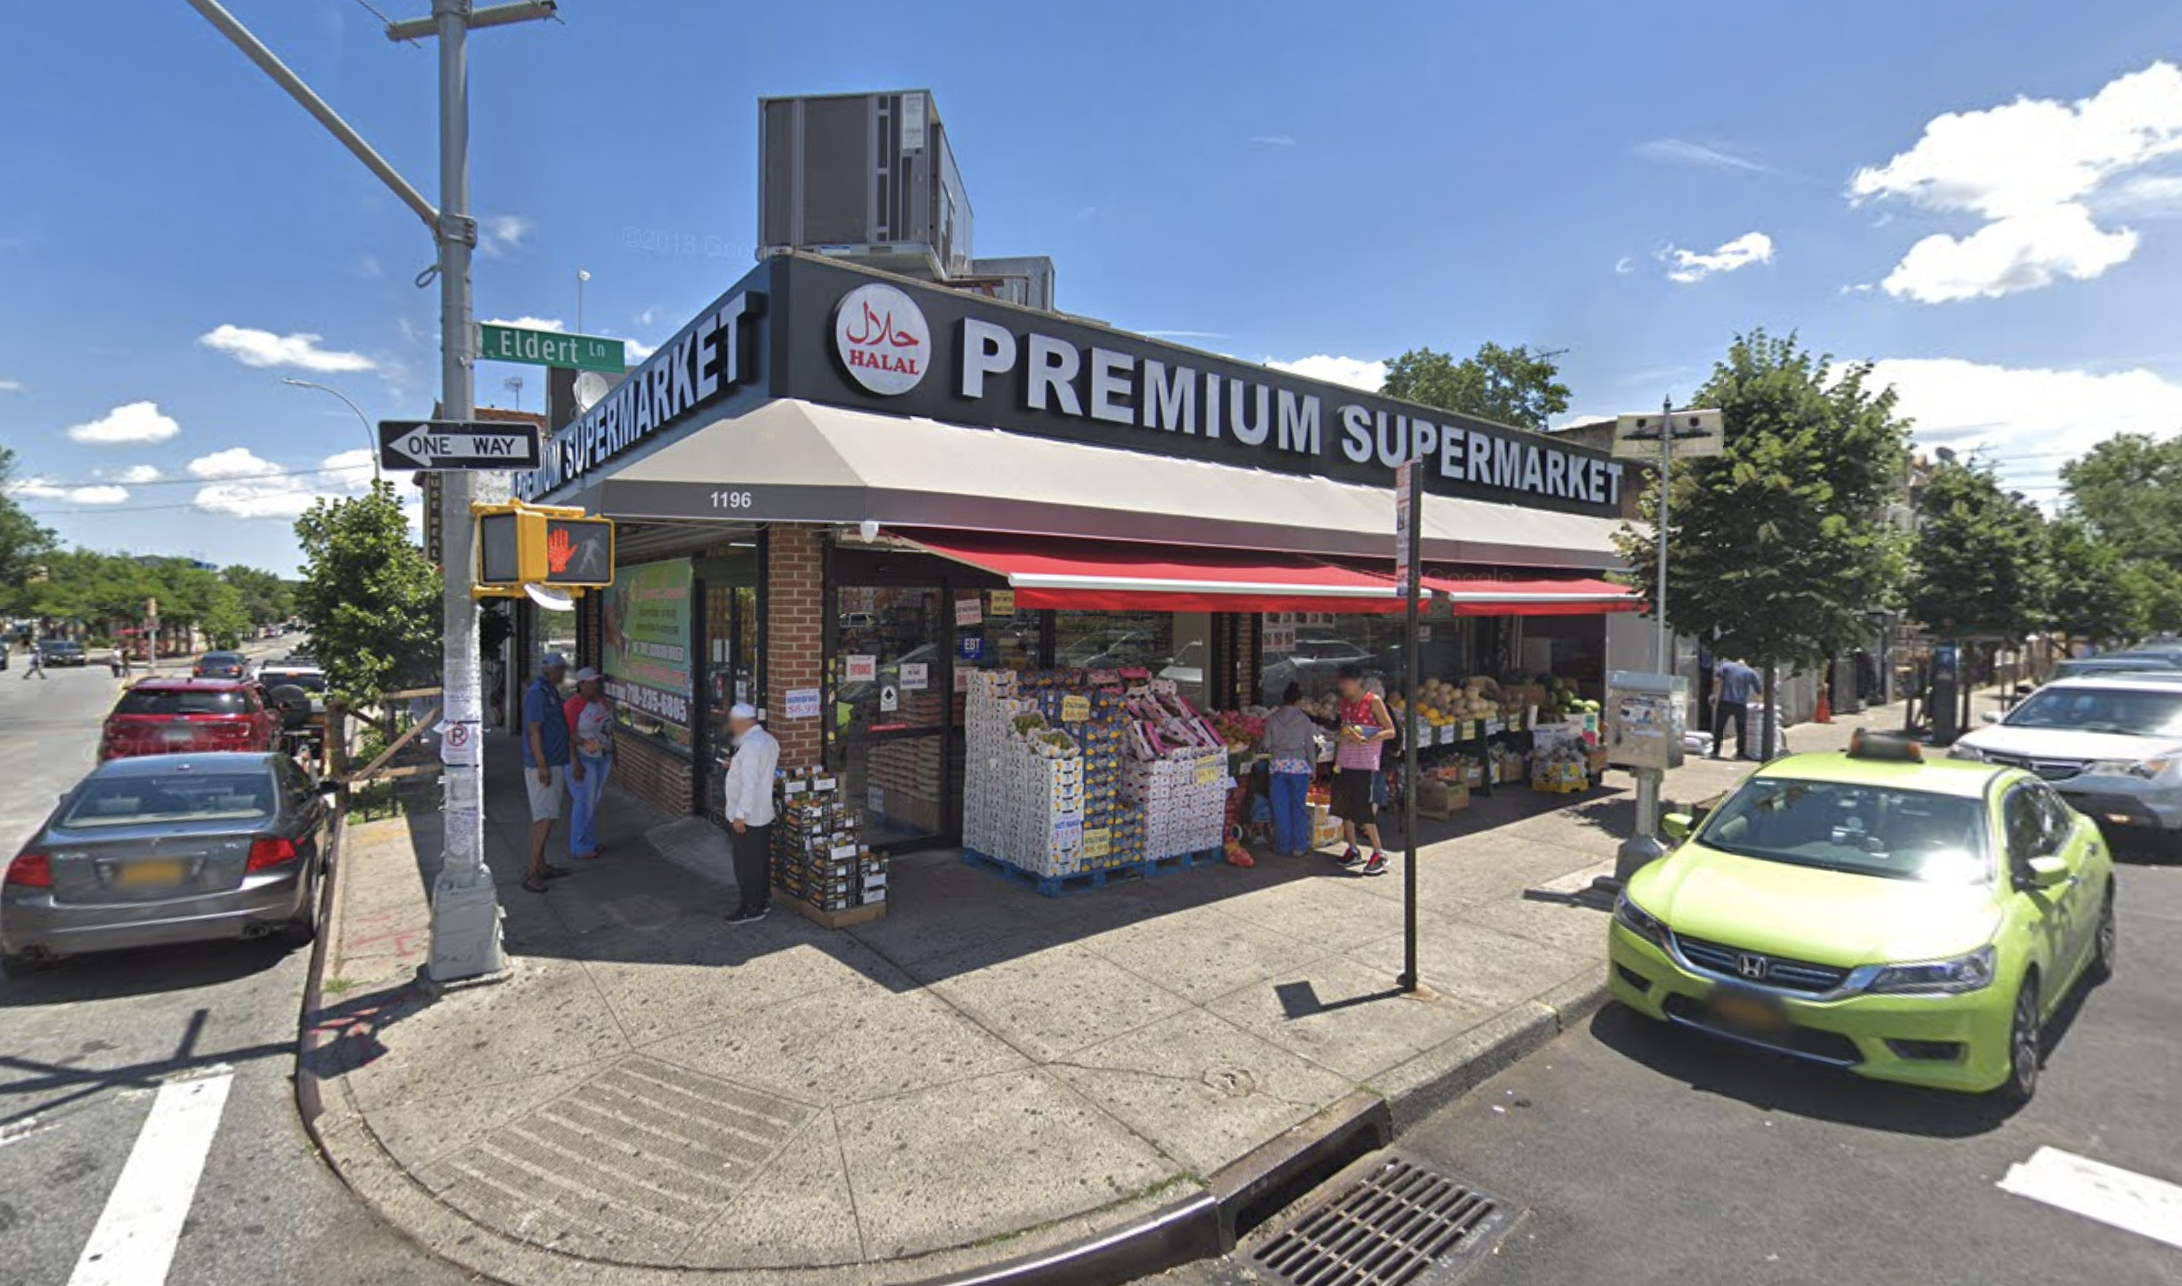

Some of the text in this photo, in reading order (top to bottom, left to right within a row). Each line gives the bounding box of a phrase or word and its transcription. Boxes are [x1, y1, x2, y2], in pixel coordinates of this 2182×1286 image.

[846, 301, 920, 347] حلال
[501, 331, 606, 363] Eldert Ln
[850, 349, 920, 376] HALAL
[565, 290, 746, 479] SUPERMARKET
[962, 318, 1623, 504] PREMIUM SUPERMARKET
[408, 436, 516, 455] ONE WAY
[710, 491, 752, 508] 1196
[963, 637, 981, 651] EBT
[788, 703, 818, 714] $8.99
